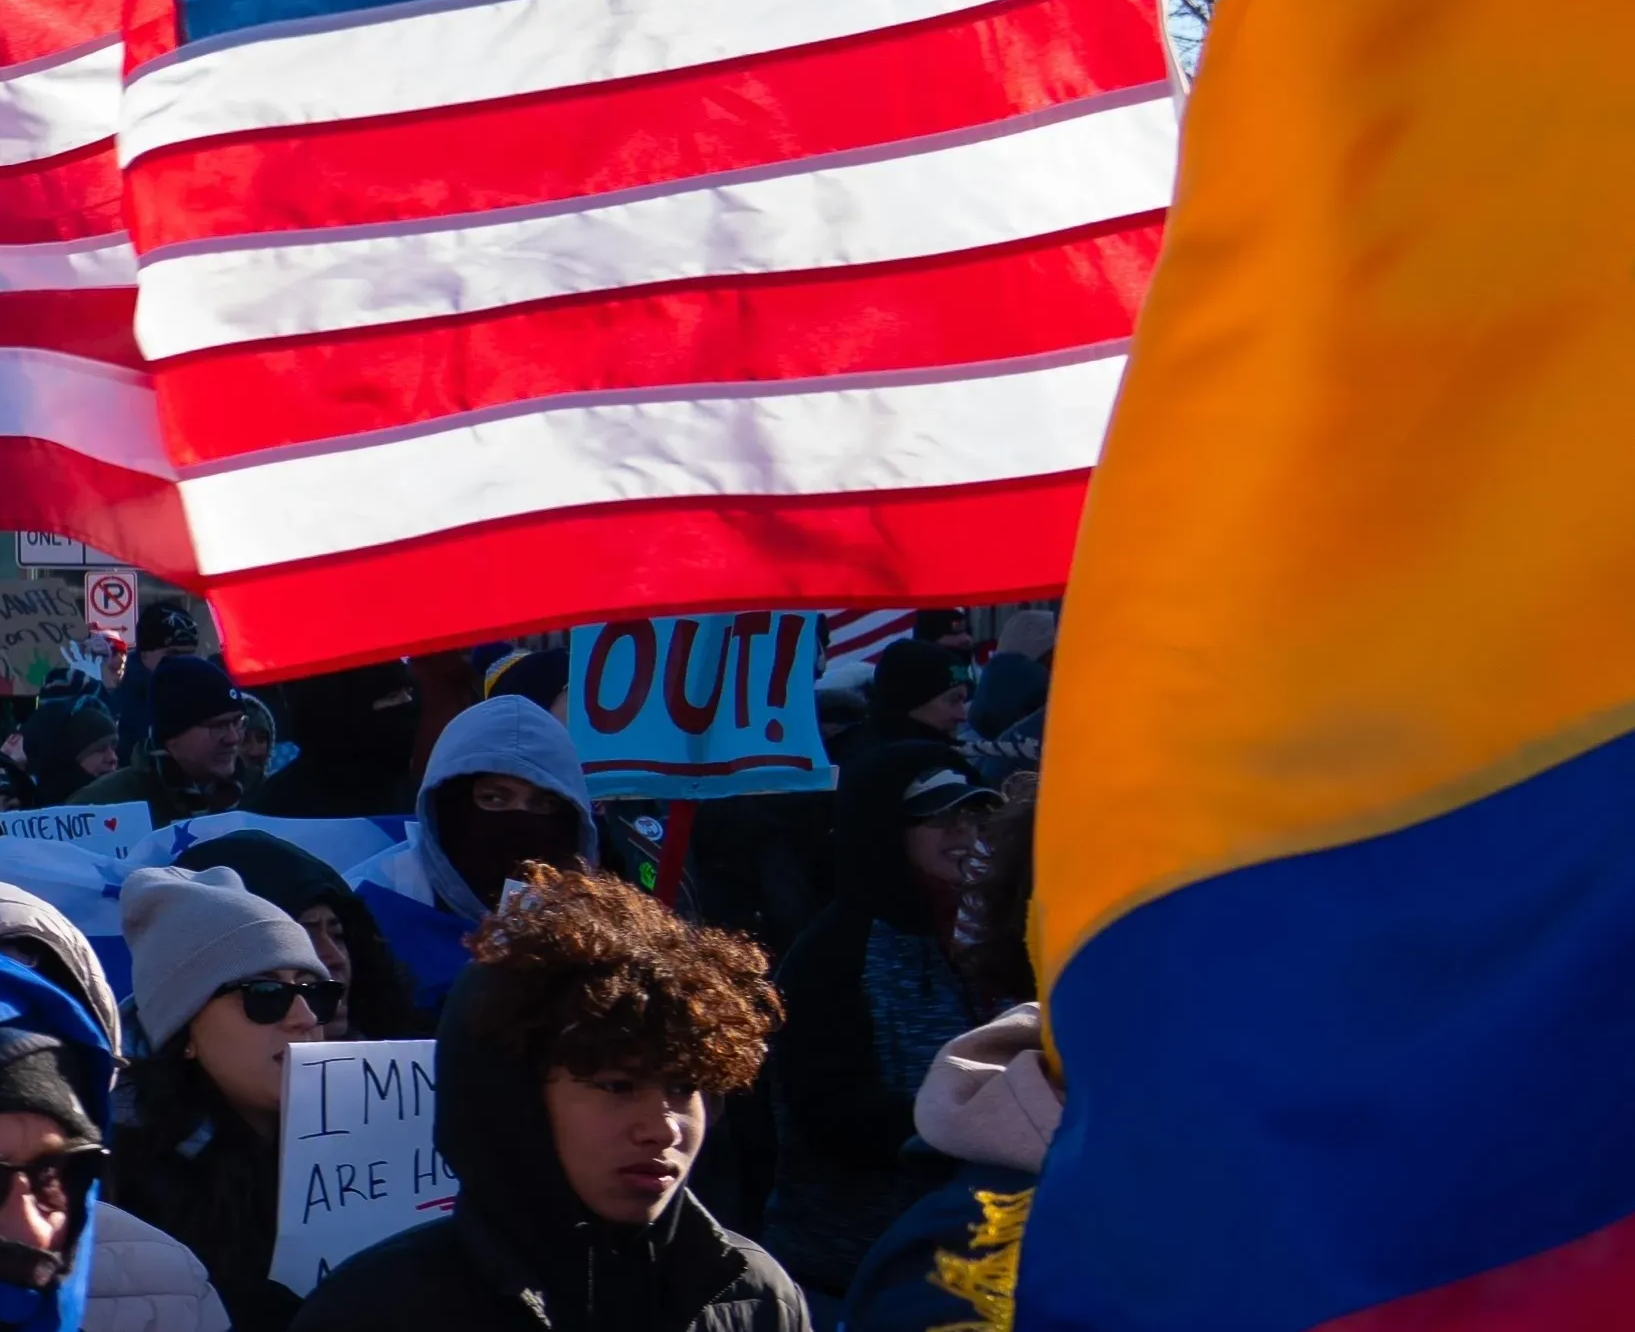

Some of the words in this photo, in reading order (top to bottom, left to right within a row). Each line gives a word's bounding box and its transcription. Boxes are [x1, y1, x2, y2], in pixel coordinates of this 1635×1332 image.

[583, 612, 806, 743] OUT!
[56, 813, 96, 841] NOT
[301, 1160, 389, 1225] ARE
